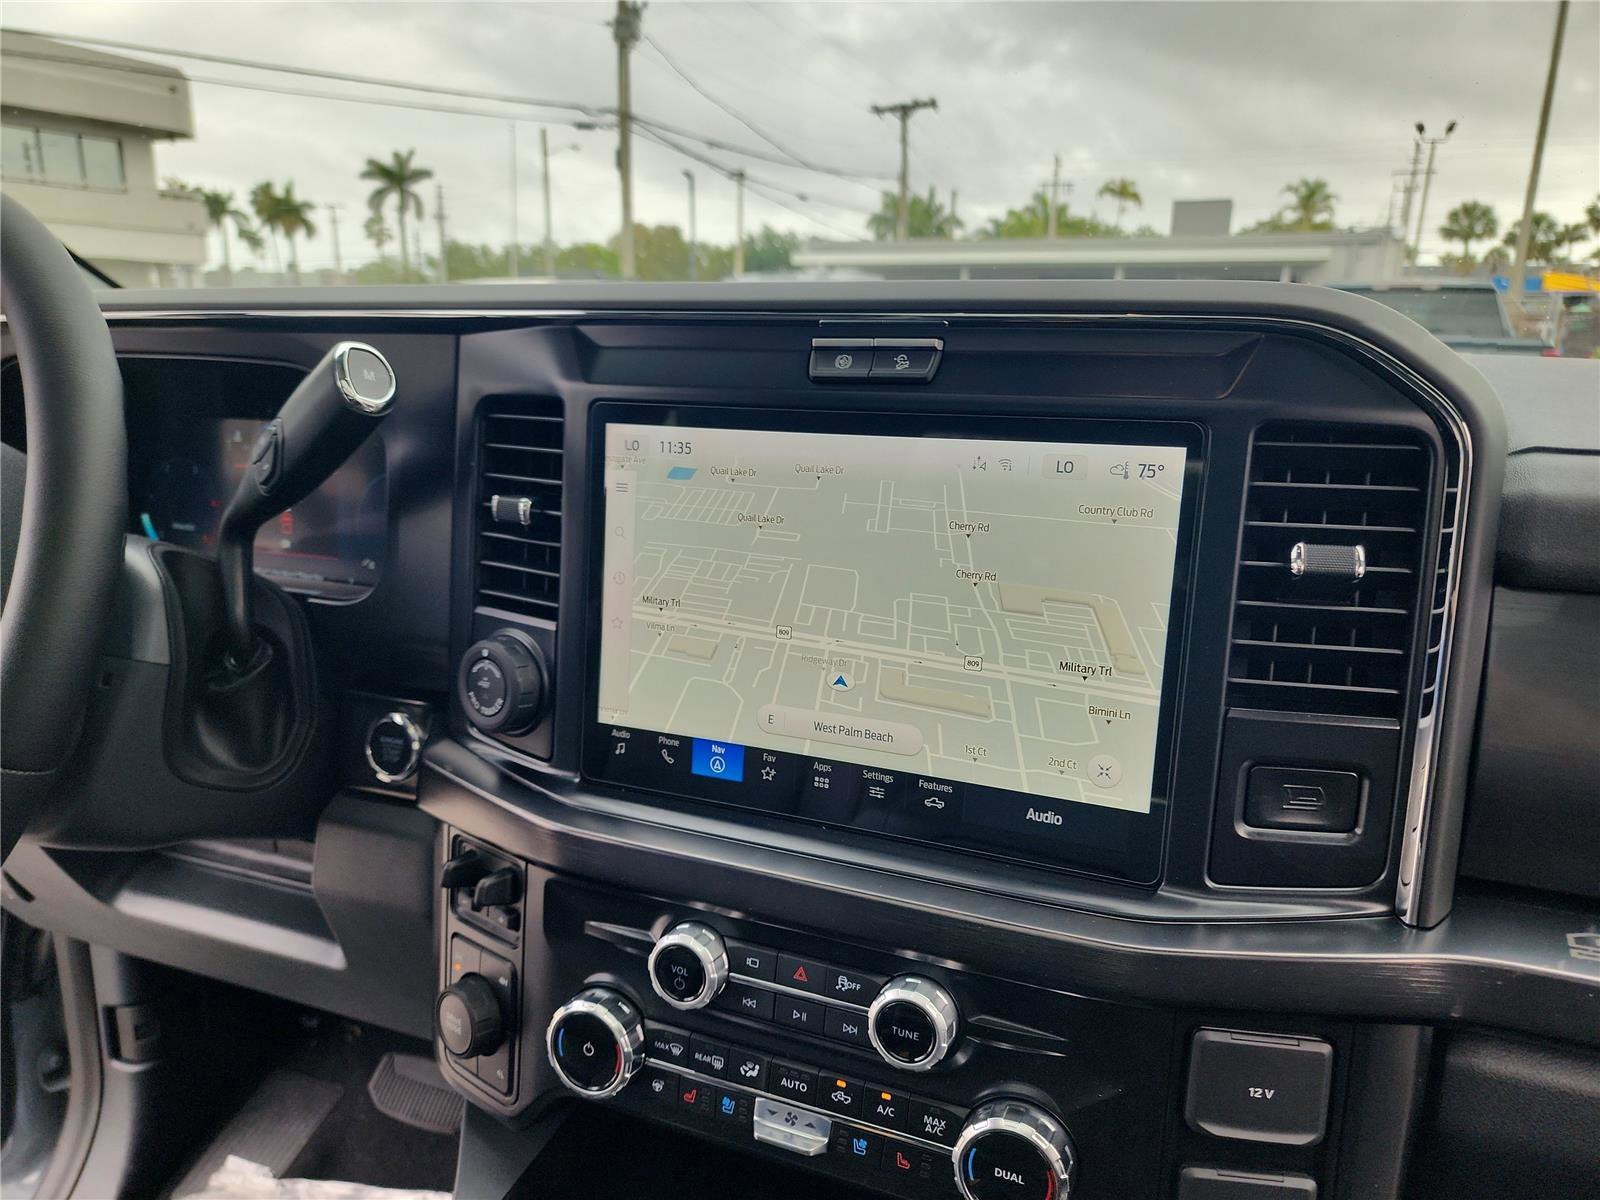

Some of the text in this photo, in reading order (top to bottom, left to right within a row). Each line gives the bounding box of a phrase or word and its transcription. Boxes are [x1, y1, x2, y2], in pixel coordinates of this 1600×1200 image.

[625, 440, 640, 451] LO
[660, 441, 692, 455] 11:35
[710, 466, 757, 477] Quail Lake Dr
[794, 463, 844, 475] Quail Lake Dr
[1056, 460, 1074, 474] LO
[1078, 504, 1154, 518] Country Club Rd
[737, 513, 784, 525] Quail Lake Dr
[949, 521, 990, 533] Cherry Rd
[956, 569, 997, 581] Cherry Rd
[642, 595, 681, 607] Military Trl
[966, 659, 980, 667] 809
[1059, 661, 1112, 676] Military Trl
[1088, 705, 1131, 720] Bimini Ln
[768, 714, 774, 725] E
[611, 728, 630, 739] Audio
[814, 721, 893, 743] West Palm Beach
[658, 736, 680, 747] Phone
[712, 744, 726, 754] Nav
[965, 744, 987, 757] 1st Ct
[763, 753, 776, 763] Fav
[1048, 757, 1077, 770] 2nd Ct
[813, 762, 832, 773] Apps
[862, 770, 894, 783] Settings
[918, 779, 953, 793] Features
[1026, 807, 1063, 826] Audio
[671, 964, 688, 976] VOL
[847, 981, 861, 991] OFF
[891, 1026, 920, 1041] TUNE
[654, 1041, 670, 1051] MAX
[695, 1053, 711, 1064] REAR
[780, 1077, 808, 1092] AUTO
[876, 1104, 895, 1117] A/C
[923, 1114, 947, 1128] MAX
[925, 1124, 944, 1137] A/C
[994, 1167, 1025, 1185] DUAL
